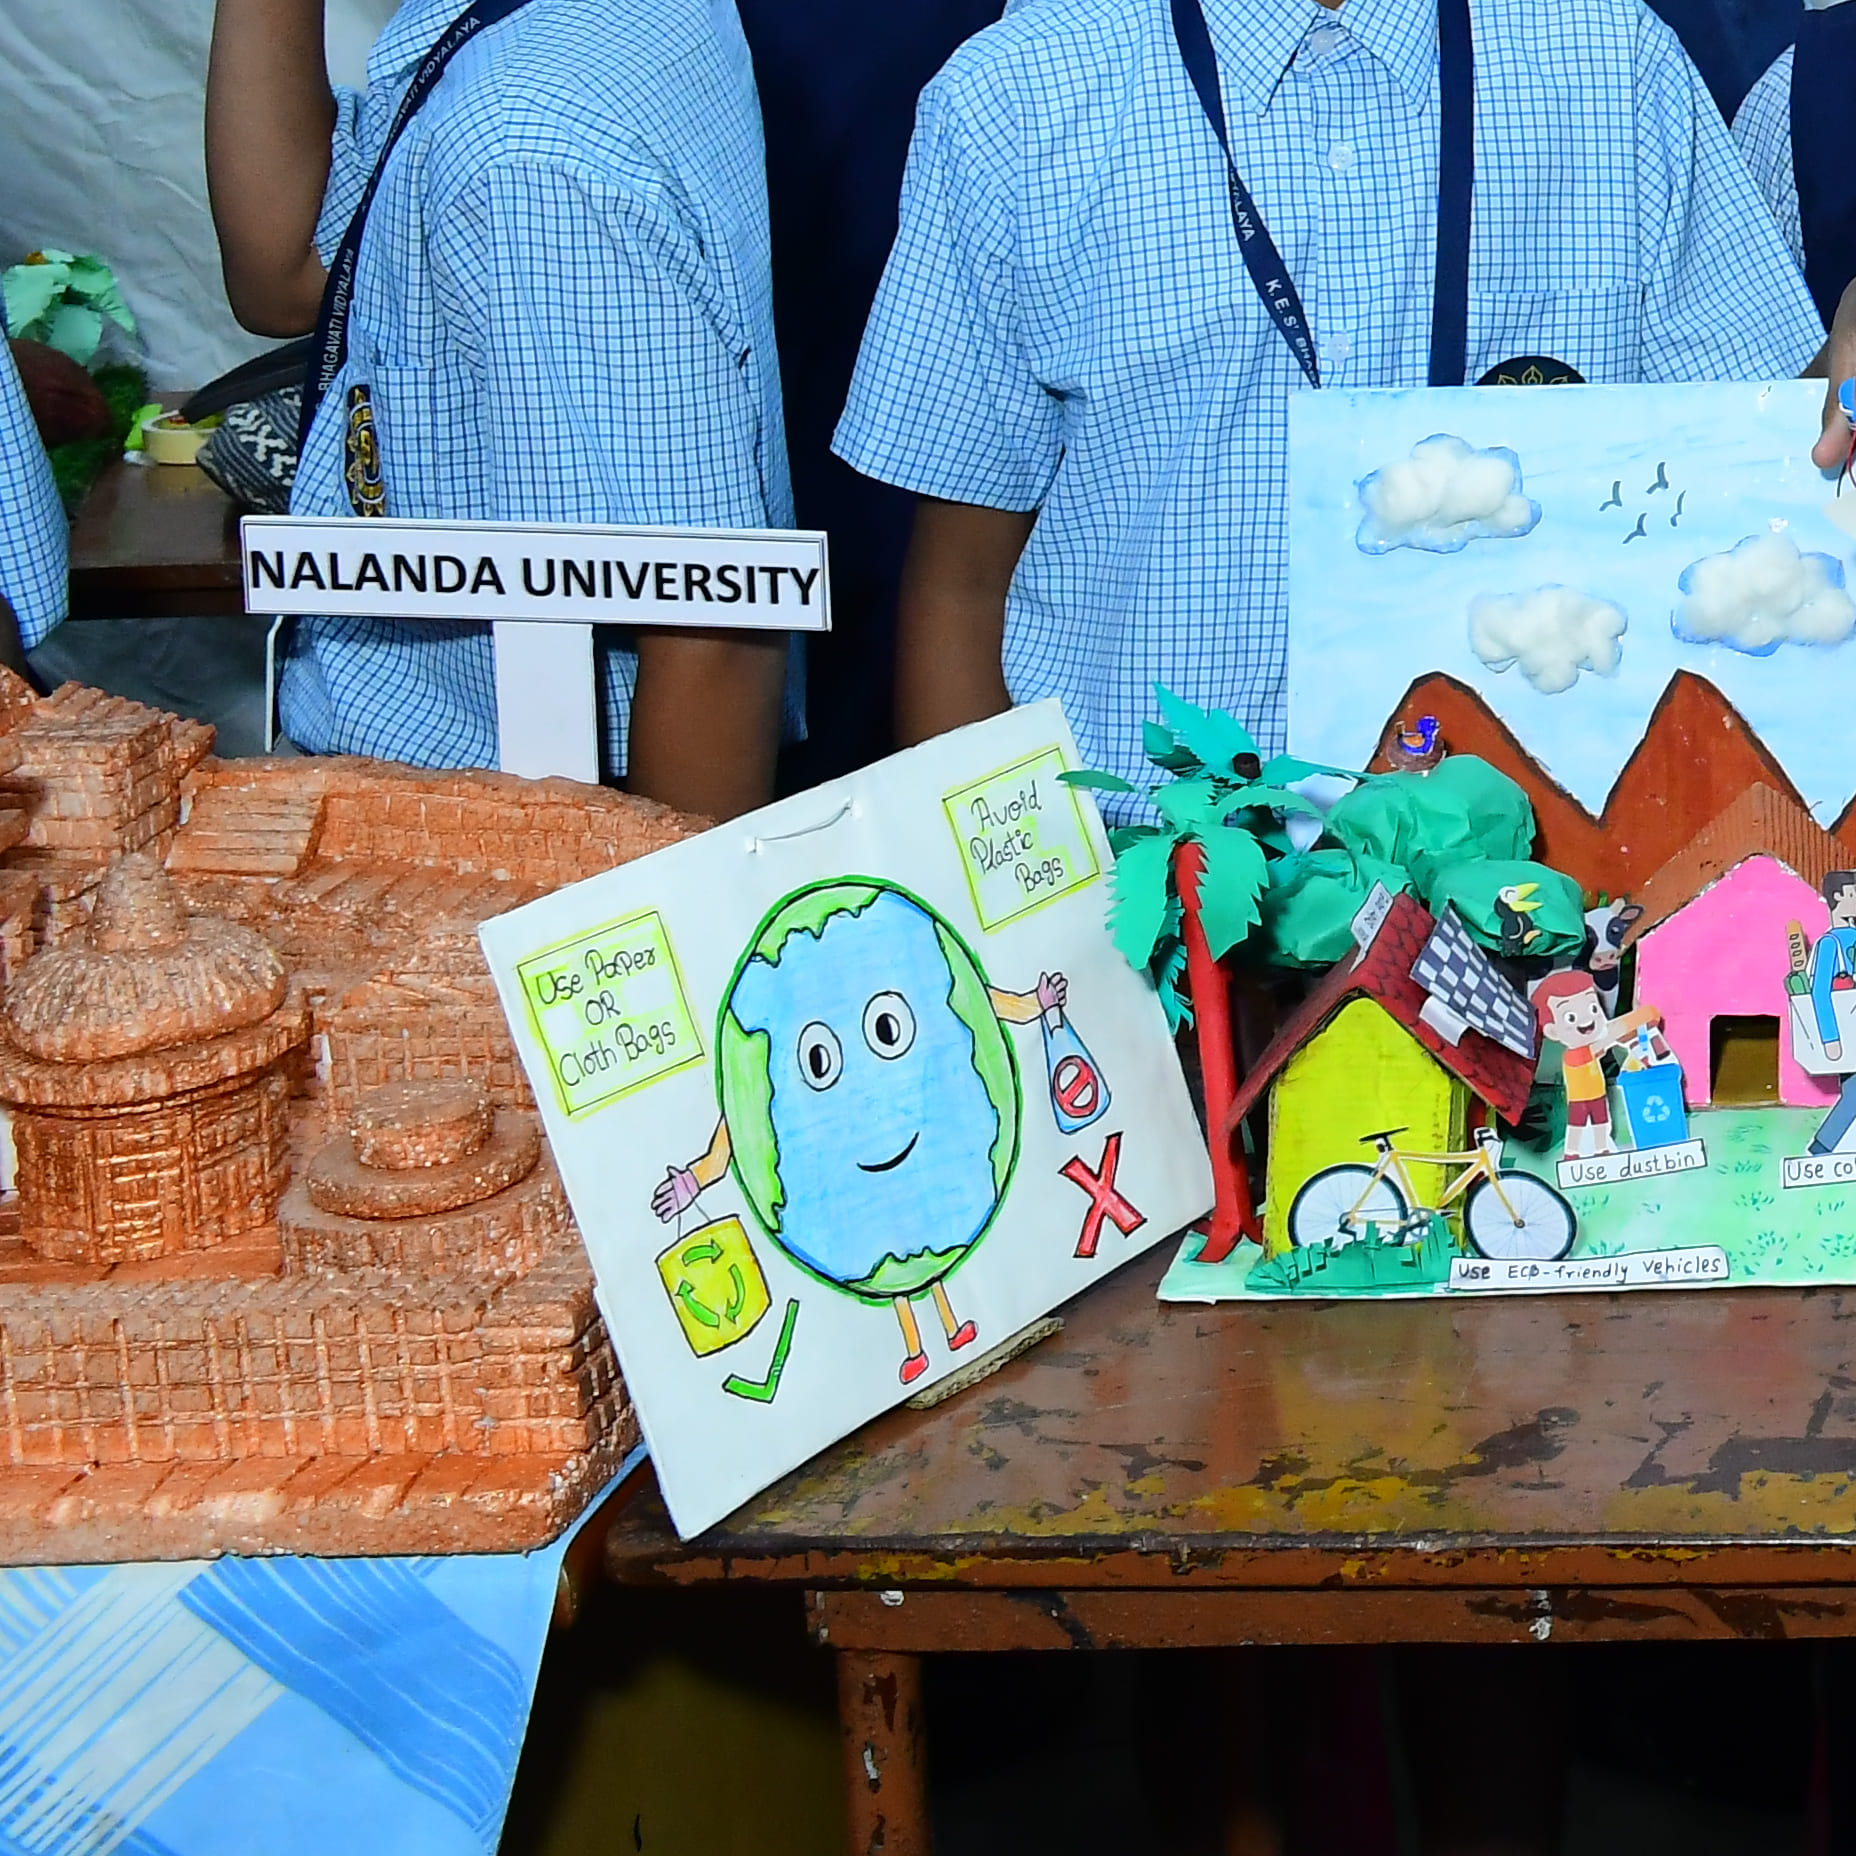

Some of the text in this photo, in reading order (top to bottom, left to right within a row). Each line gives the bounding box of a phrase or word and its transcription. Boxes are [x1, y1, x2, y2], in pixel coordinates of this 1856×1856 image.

[247, 548, 823, 607] NALANDA UNIVERSITY
[971, 779, 1042, 831] Avoid
[970, 829, 1034, 875] Plastic
[1015, 857, 1064, 893] Bags
[536, 971, 584, 1004] Use
[585, 990, 621, 1026] OR
[559, 1021, 676, 1086] Cloth Bags
[1571, 1152, 1696, 1182] Use dustbin
[1787, 1161, 1824, 1179] Use
[1458, 1263, 1490, 1280] Use
